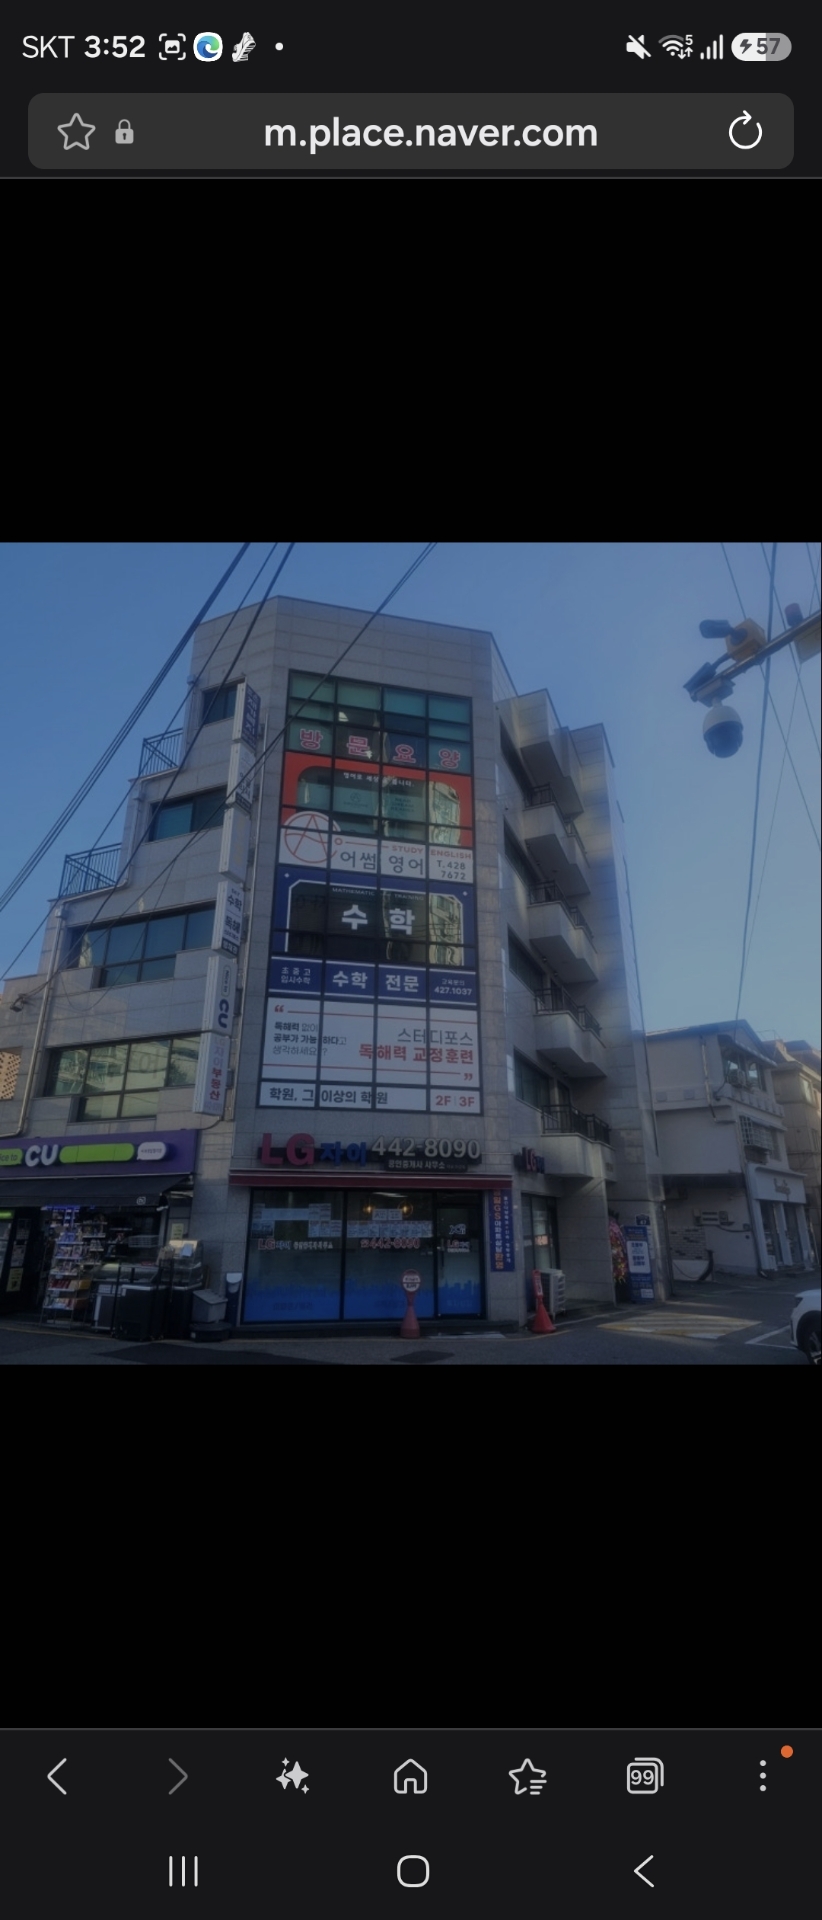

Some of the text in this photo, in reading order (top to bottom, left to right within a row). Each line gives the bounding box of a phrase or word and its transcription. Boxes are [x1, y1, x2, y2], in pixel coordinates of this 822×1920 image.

[22, 35, 146, 58] SKT 3:52
[756, 38, 781, 55] 57
[264, 116, 598, 154] m.place.naver.com
[392, 844, 472, 860] STUDY ENGLISH
[340, 851, 424, 875] 어썸 영어
[440, 870, 466, 881] 7672
[342, 904, 416, 935] 수학
[332, 970, 419, 992] 수학 전문
[434, 986, 472, 995] 427.1037
[218, 999, 230, 1028] CU
[275, 1022, 299, 1031] 독해력
[274, 1033, 299, 1043] 공부가
[398, 1028, 473, 1046] 스터디포스
[359, 1044, 406, 1061] 독해력
[209, 1068, 222, 1101] 부동산
[269, 1087, 388, 1104] 학원, 그 이상의 학원
[436, 1095, 475, 1107] 2F 3F
[0, 1152, 10, 1161] ice
[25, 1144, 58, 1167] CU
[372, 1135, 480, 1159] 442-8090
[630, 1769, 655, 1786] 99
